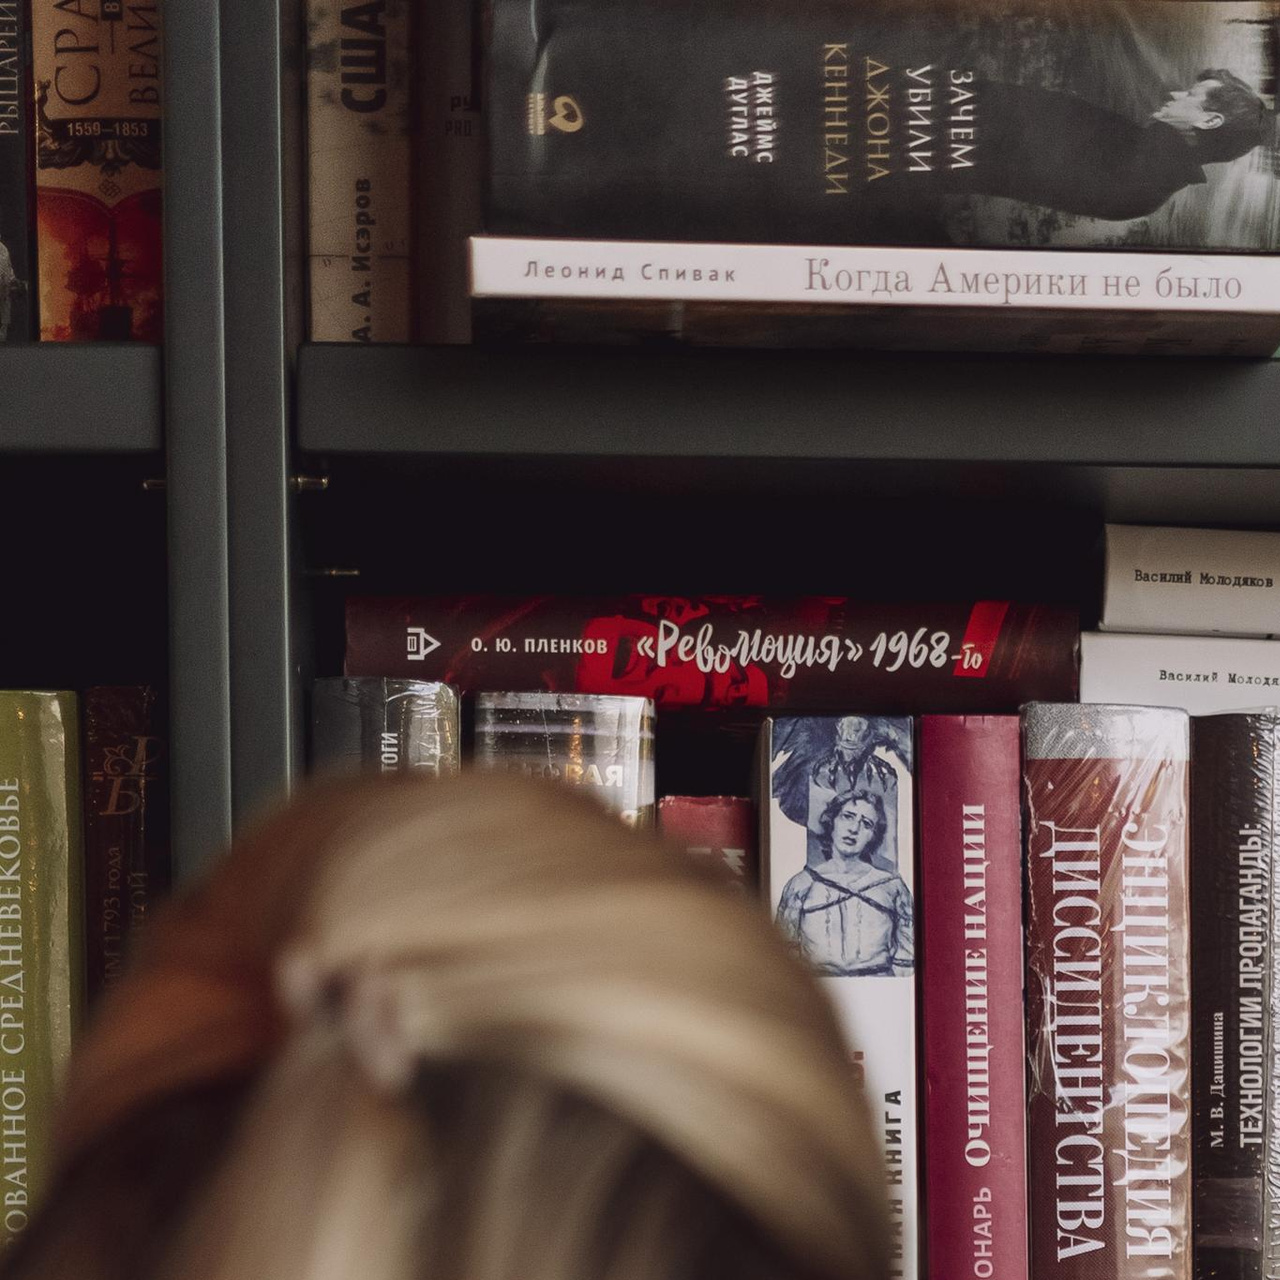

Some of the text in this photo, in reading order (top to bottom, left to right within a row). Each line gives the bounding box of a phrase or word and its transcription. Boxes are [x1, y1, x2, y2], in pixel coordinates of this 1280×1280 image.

[727, 77, 749, 157] ДУГЛАС
[753, 71, 777, 163] ДЖЕЙМС
[824, 43, 848, 194] КЕННЕДИ
[866, 57, 890, 182] ДЖОНА
[906, 64, 934, 172] УБИЛИ
[950, 69, 974, 169] ЗАЧЕМ
[524, 261, 736, 284] Леонид Спивак
[804, 257, 1243, 304] Когда Америки не было
[1135, 568, 1274, 589] Василий Молодяков
[962, 804, 990, 940] НАЦИИ
